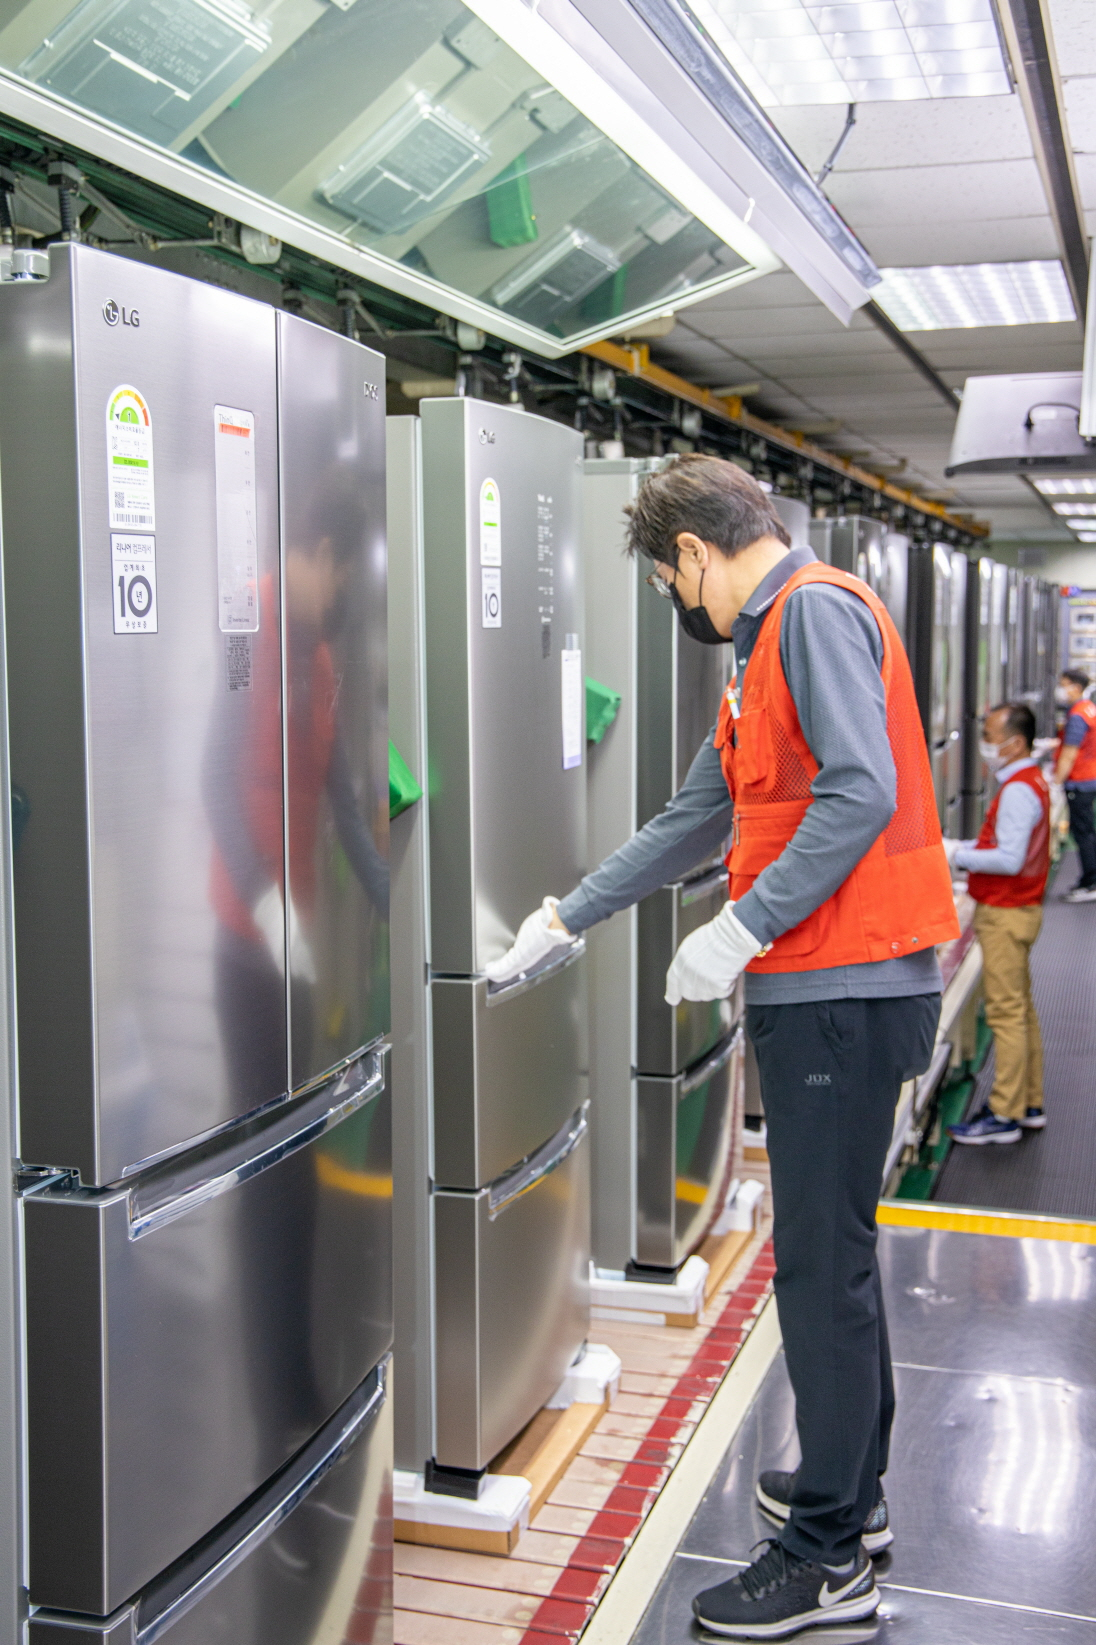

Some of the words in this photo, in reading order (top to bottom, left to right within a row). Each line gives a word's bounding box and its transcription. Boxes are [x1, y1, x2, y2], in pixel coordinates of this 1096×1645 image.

[122, 306, 140, 327] LG
[118, 574, 153, 618] 10
[484, 593, 499, 618] 10
